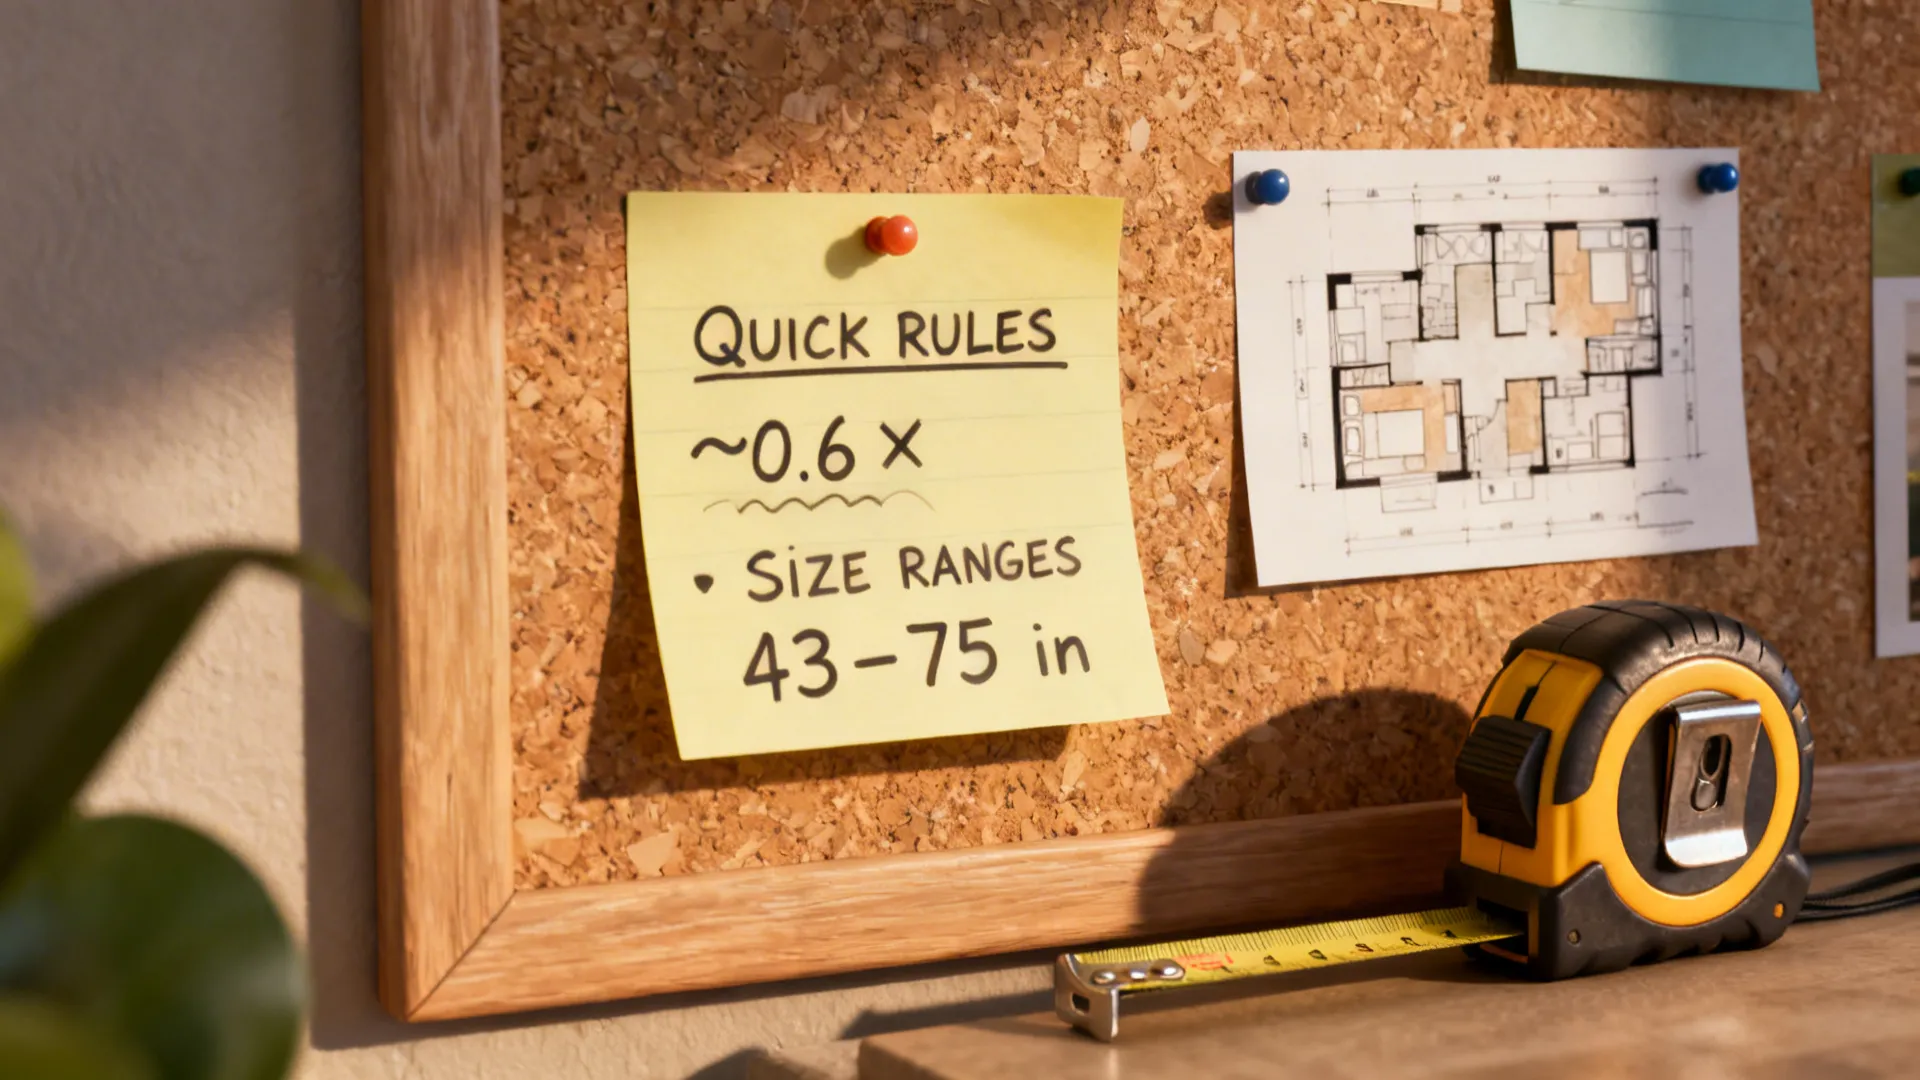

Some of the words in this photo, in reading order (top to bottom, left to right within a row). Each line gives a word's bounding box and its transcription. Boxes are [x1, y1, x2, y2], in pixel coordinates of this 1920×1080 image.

[693, 304, 871, 368] QUICK
[896, 307, 1057, 359] RULES
[898, 535, 1082, 590] RANGES
[1031, 622, 1092, 677] in
